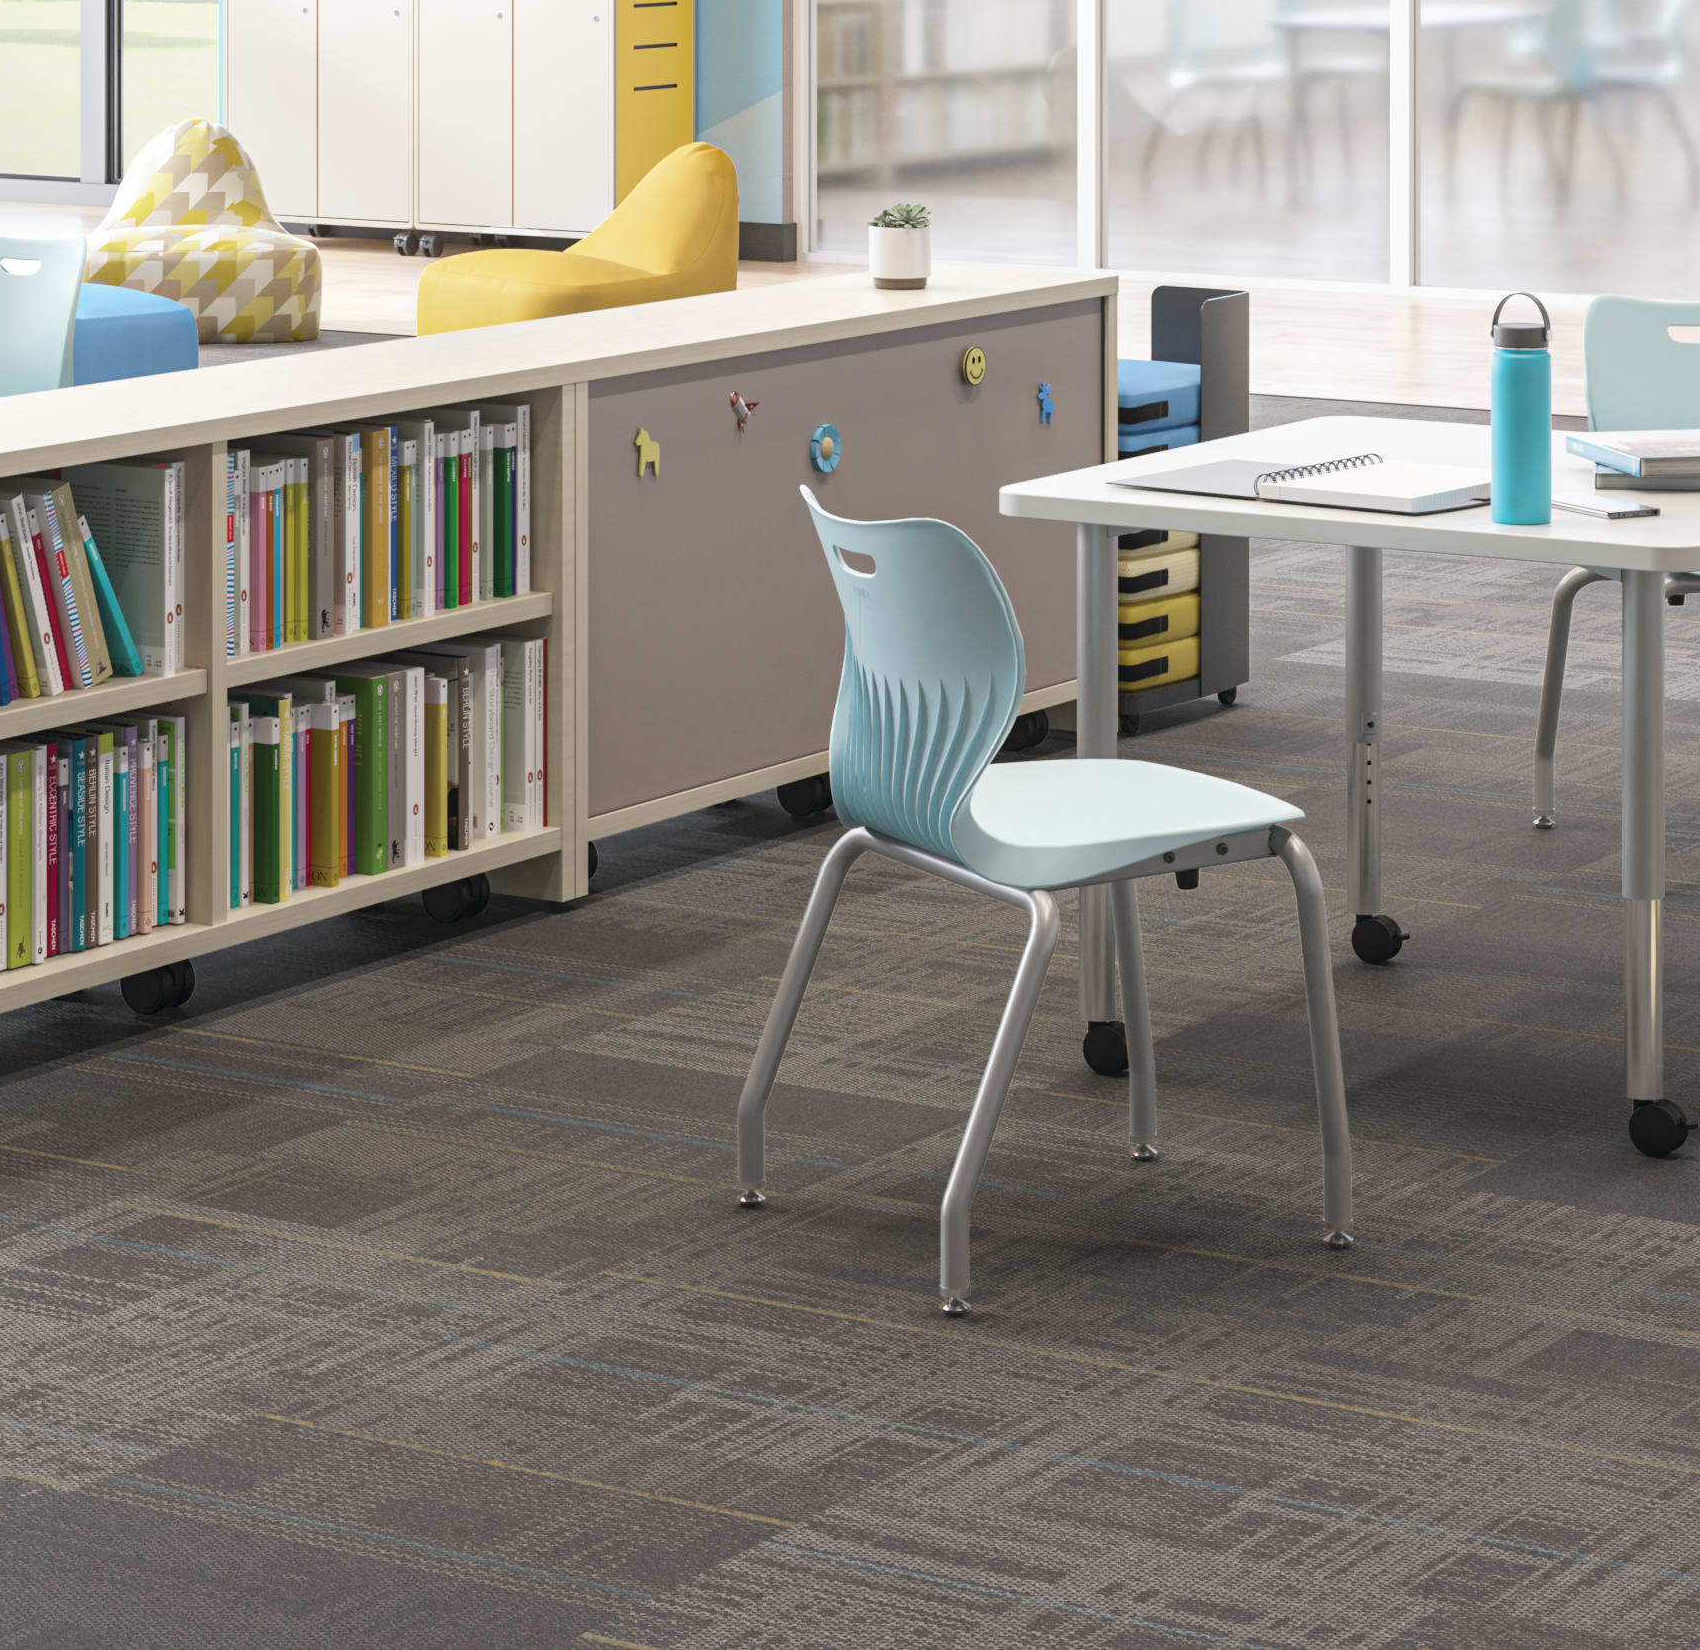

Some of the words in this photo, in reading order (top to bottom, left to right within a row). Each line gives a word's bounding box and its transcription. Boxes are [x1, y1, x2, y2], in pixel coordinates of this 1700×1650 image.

[488, 688, 496, 740] Storyboard
[77, 771, 86, 813] SEASIDE
[88, 769, 97, 806] BERLIN
[103, 785, 111, 814] Design
[129, 757, 138, 811] PROVENCE
[49, 776, 58, 832] ECCENTRIC
[77, 816, 86, 847] STYLE
[88, 807, 97, 838] STYLE
[129, 814, 138, 844] STYLE
[49, 834, 58, 866] STYLE
